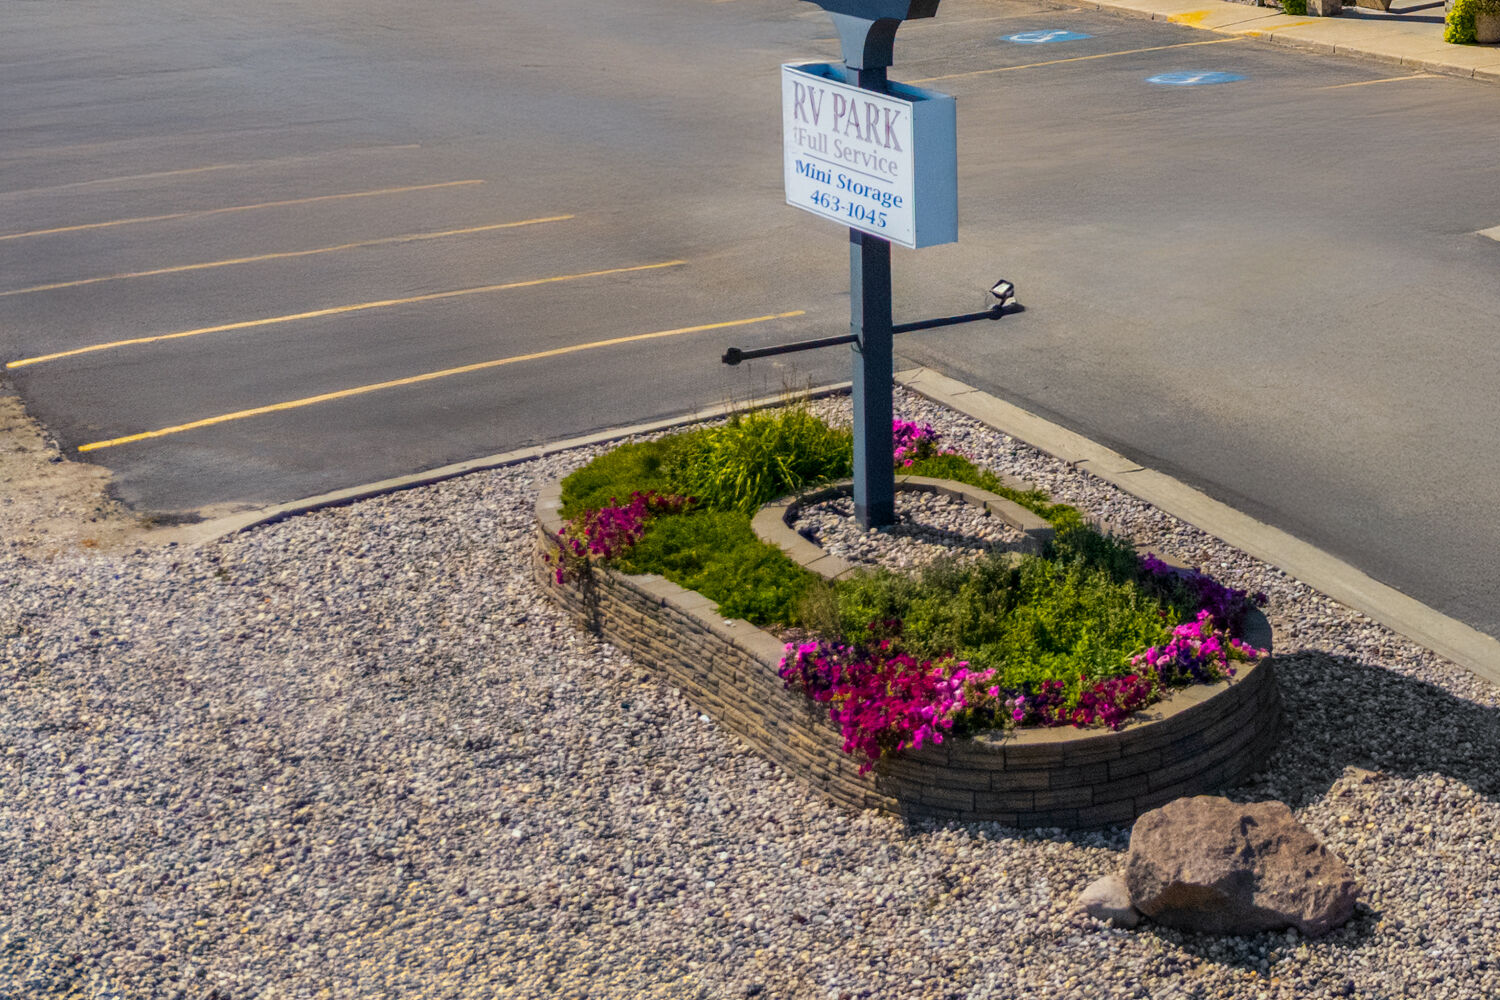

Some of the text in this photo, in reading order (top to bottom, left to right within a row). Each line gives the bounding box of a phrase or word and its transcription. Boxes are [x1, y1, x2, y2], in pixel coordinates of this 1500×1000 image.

[793, 81, 903, 152] RV PARK
[794, 127, 898, 176] Full Service
[795, 159, 903, 208] Mini Storage
[810, 190, 887, 228] 463-1045
